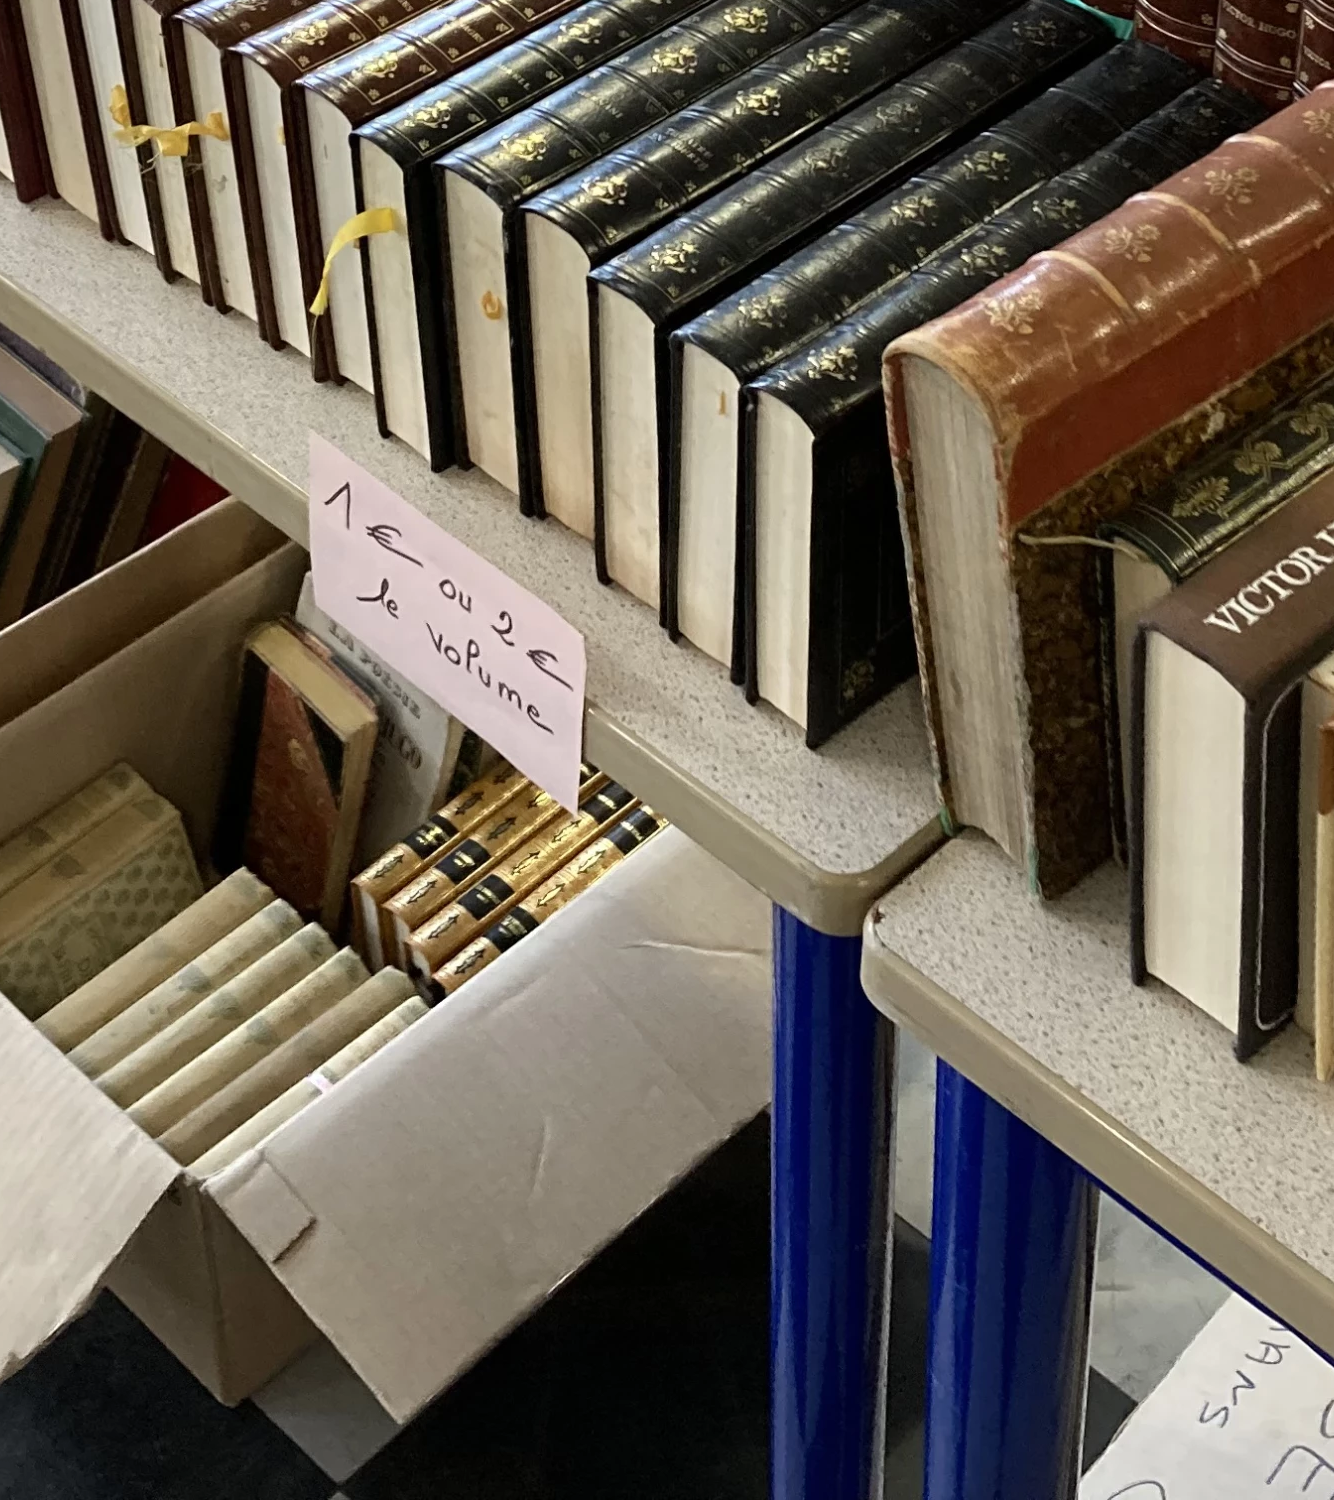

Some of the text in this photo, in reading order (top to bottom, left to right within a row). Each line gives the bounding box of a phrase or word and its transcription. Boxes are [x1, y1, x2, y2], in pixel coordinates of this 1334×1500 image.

[1257, 20, 1298, 40] HUGO
[324, 481, 575, 692] 1 € ou 2 €
[355, 577, 556, 736] le volume
[1197, 1324, 1295, 1429] ANS
